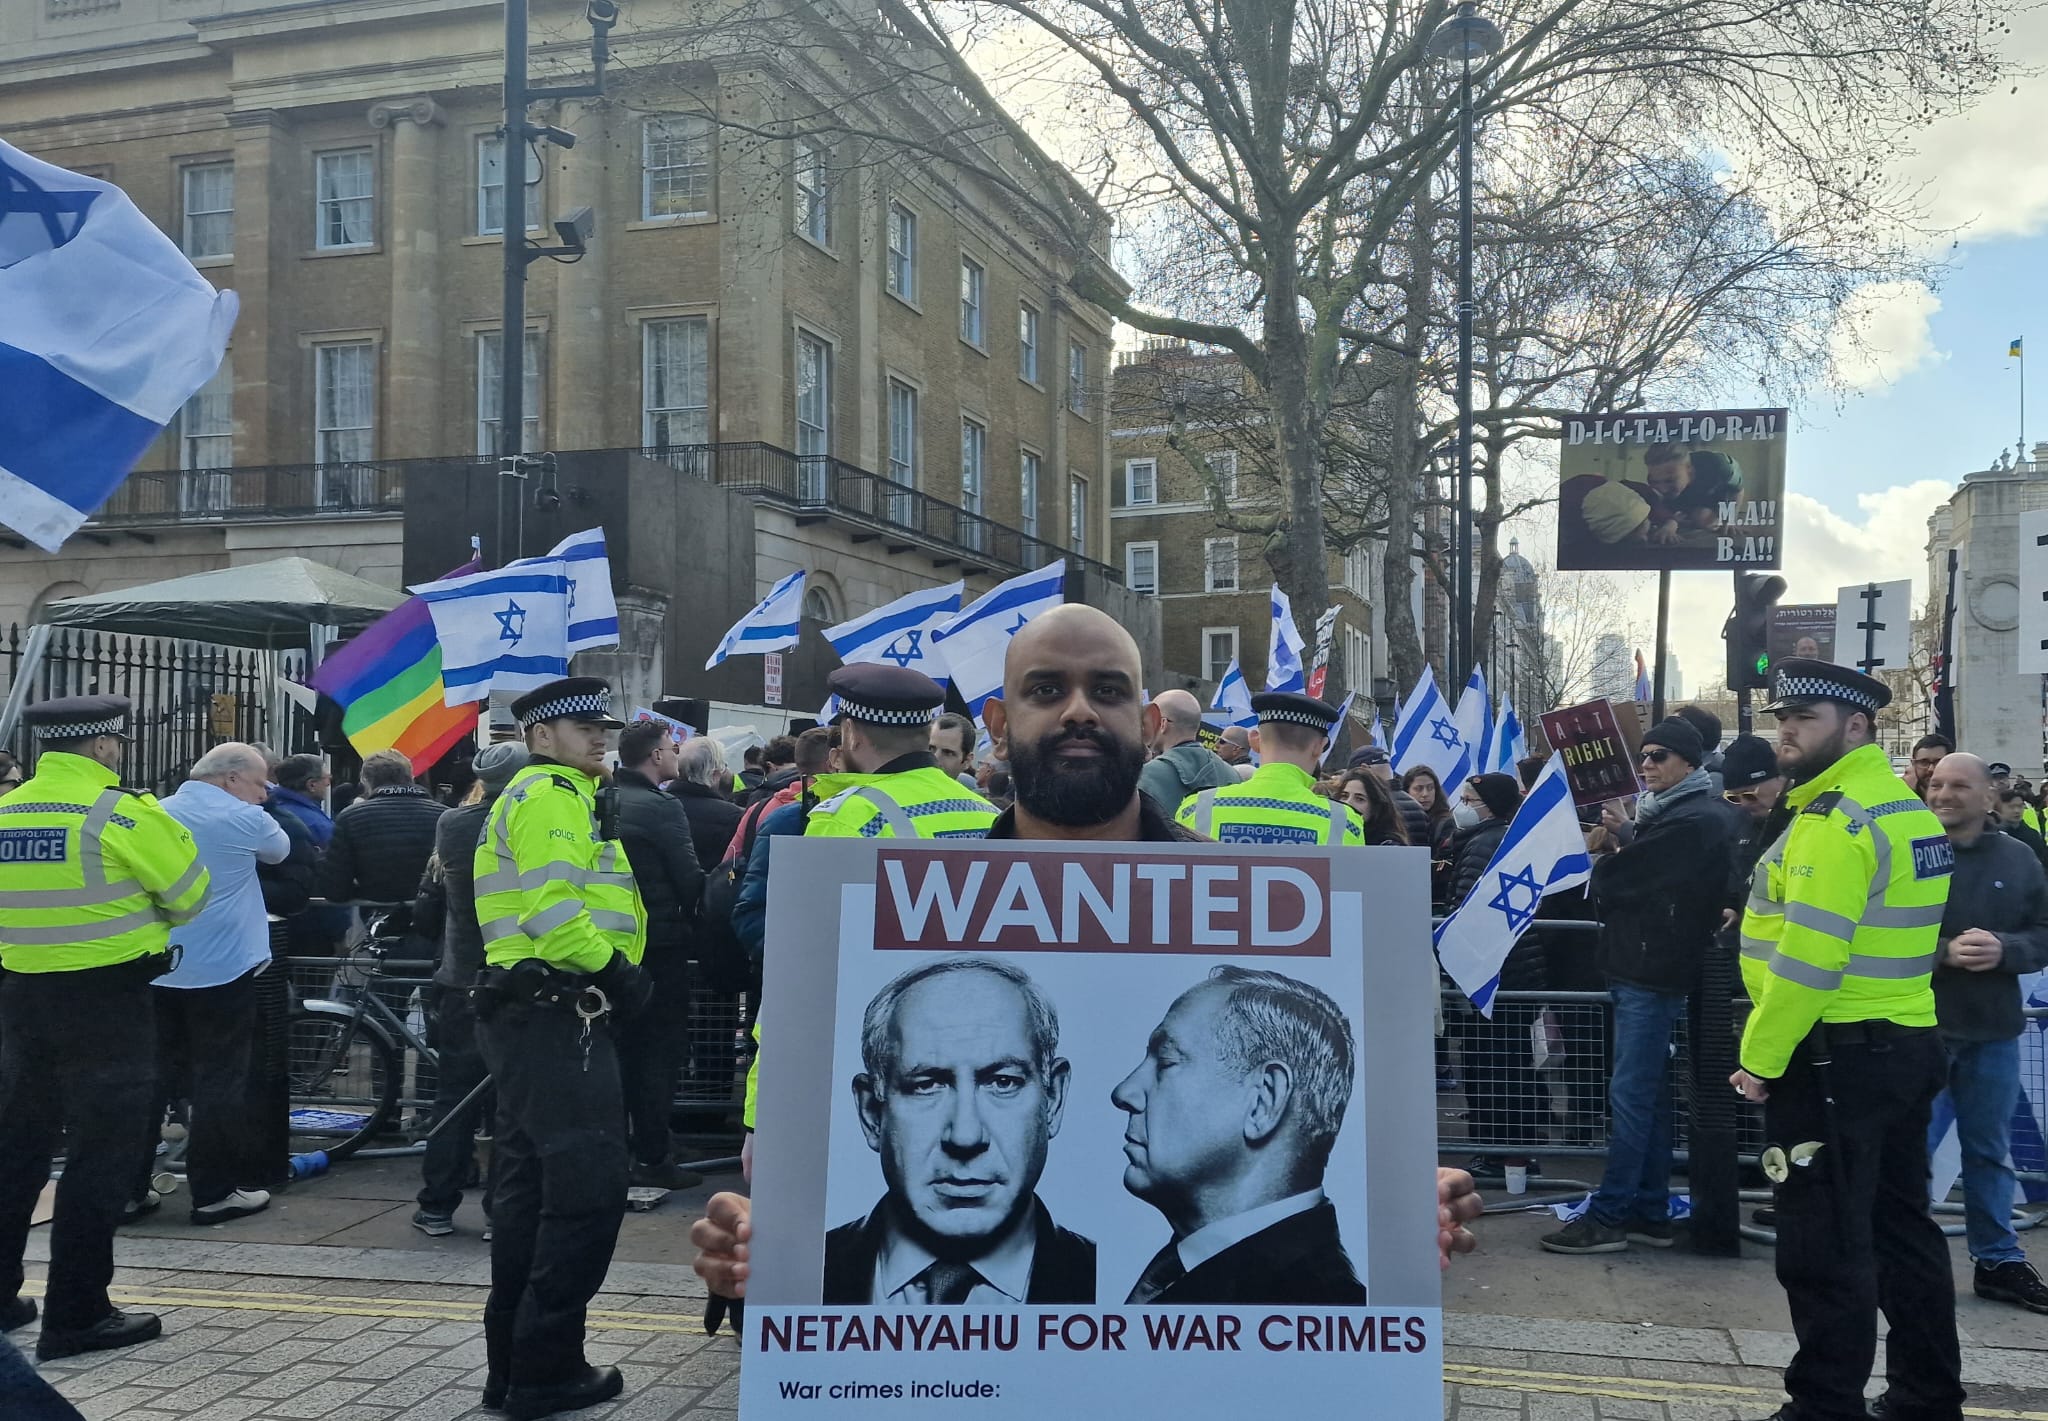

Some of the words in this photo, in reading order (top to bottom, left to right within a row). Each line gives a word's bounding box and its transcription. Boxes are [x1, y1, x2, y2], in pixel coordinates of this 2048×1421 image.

[1568, 415, 1776, 446] D-I-C-T-A-T-O-R-A!
[1717, 501, 1776, 526] M.A!!
[1716, 537, 1774, 562] B.A!!
[1563, 736, 1615, 767] RIGHT
[0, 830, 64, 839] TROPOLITAN
[549, 828, 576, 842] POLICE
[1221, 825, 1316, 840] METROPOLITAN
[0, 840, 63, 860] OLICE
[1914, 842, 1955, 871] POLICE
[883, 859, 1324, 947] WANTED
[760, 1314, 1019, 1352] NETANYAHU
[1038, 1313, 1127, 1351] FOR
[1142, 1314, 1241, 1351] WAR
[1258, 1314, 1427, 1353] CRIMES
[779, 1381, 822, 1399] War
[829, 1381, 903, 1399] crimes
[911, 1380, 1000, 1398] include:
